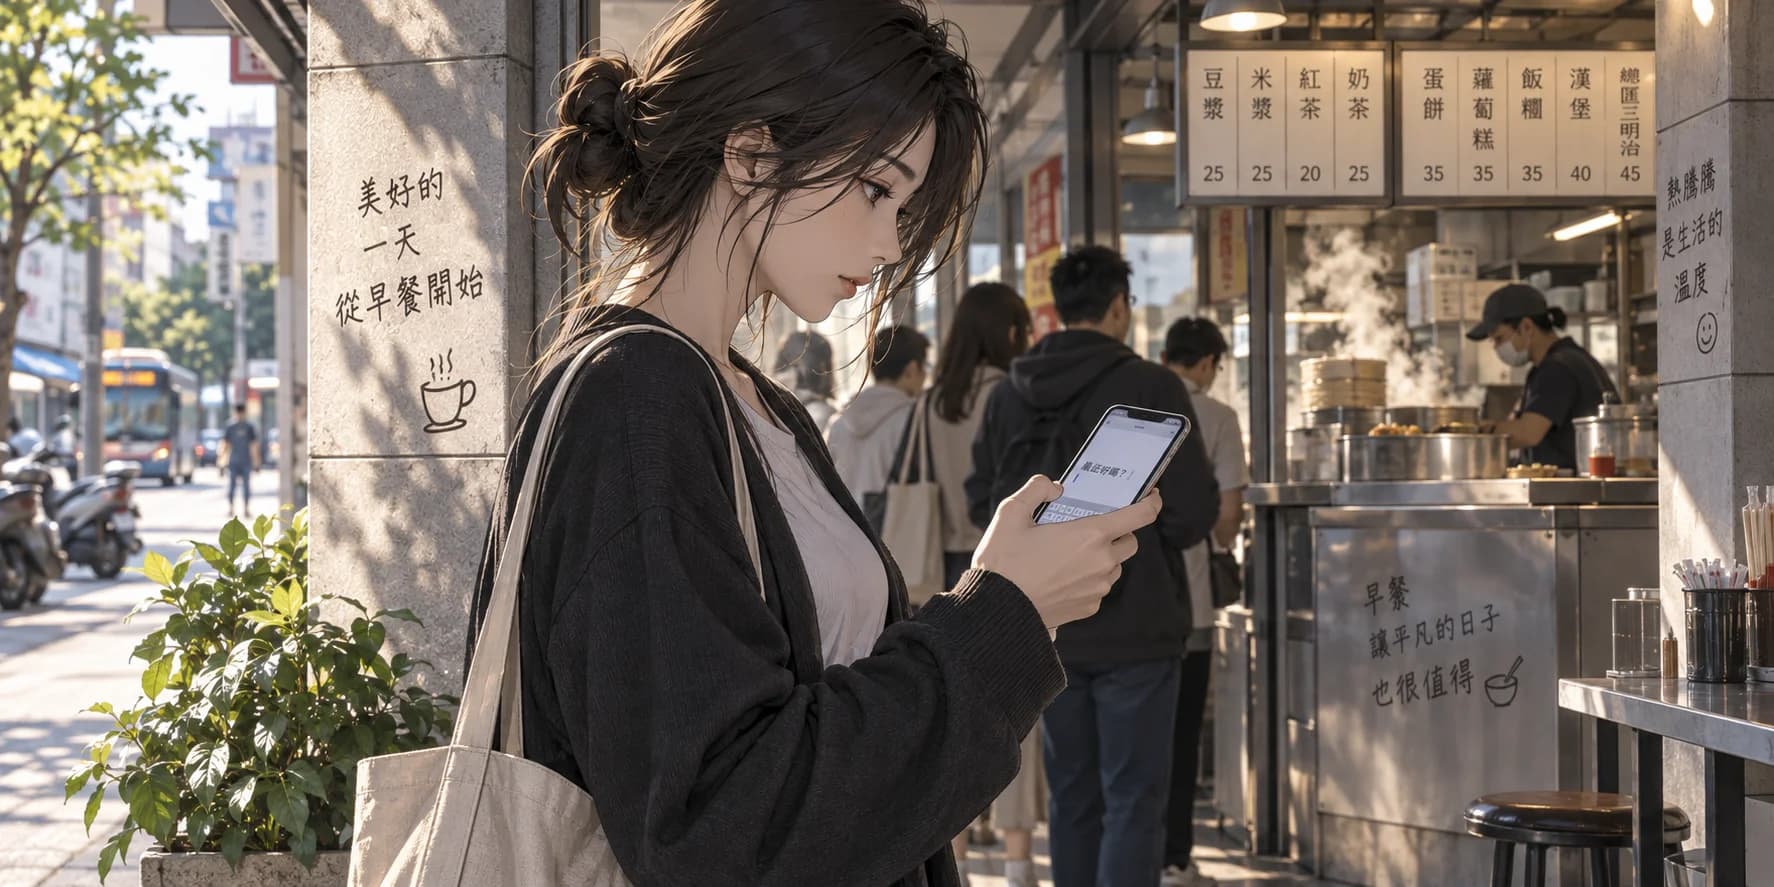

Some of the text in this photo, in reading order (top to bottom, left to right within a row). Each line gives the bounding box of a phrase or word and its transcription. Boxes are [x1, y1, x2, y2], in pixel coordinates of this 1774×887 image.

[1203, 67, 1224, 120] 豆漿
[1252, 67, 1272, 120] 米漿
[1299, 67, 1321, 120] 紅茶
[1348, 67, 1370, 120] 奶茶
[1423, 67, 1444, 120] 蛋餅
[1570, 67, 1591, 120] 漢堡
[1619, 67, 1640, 157] 總匯三明治
[358, 167, 443, 218] 美好的
[1203, 165, 1224, 182] 25
[1252, 165, 1273, 182] 25
[1300, 165, 1321, 182] 20
[1348, 165, 1369, 182] 25
[1423, 165, 1444, 182] 35
[1473, 165, 1494, 182] 35
[1522, 165, 1543, 182] 35
[1570, 165, 1591, 182] 40
[1620, 165, 1641, 182] 45
[1667, 156, 1716, 210] 熱騰騰
[363, 223, 420, 261] 一天
[1662, 207, 1723, 262] 是生活的
[335, 263, 484, 328] 從早餐開始
[1364, 575, 1410, 617] 早餐
[1369, 603, 1501, 660] 讓平凡的日子
[1372, 657, 1475, 708] 也很值得
